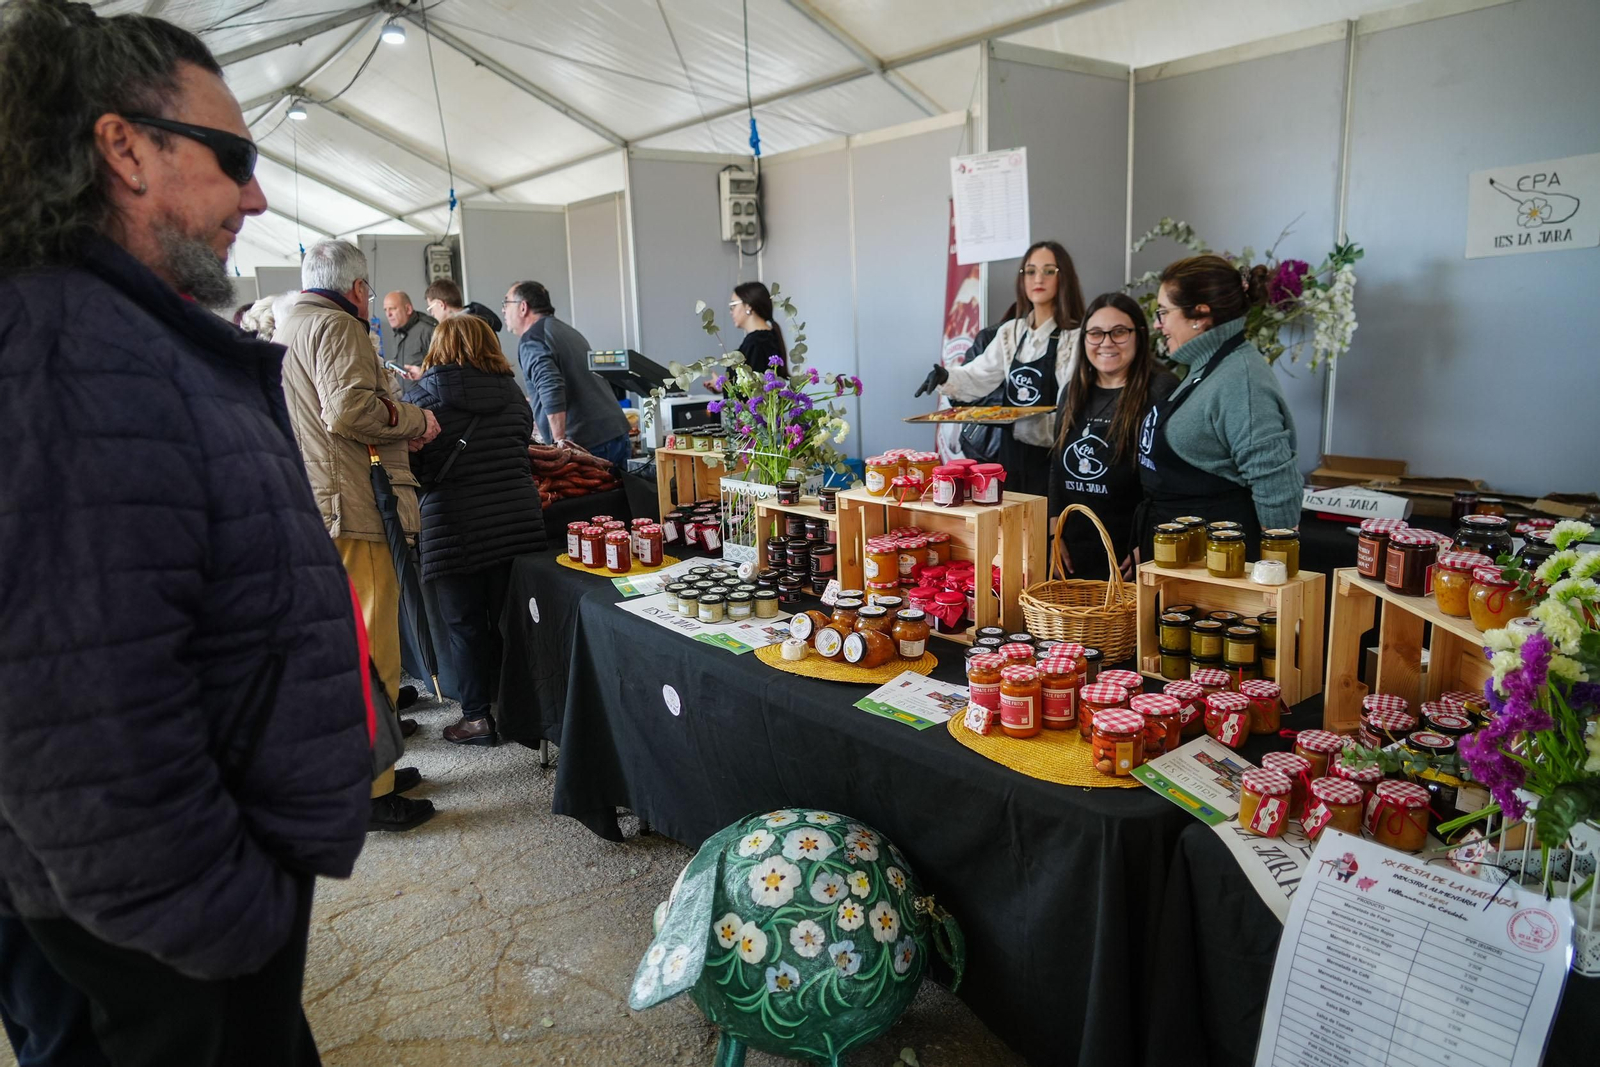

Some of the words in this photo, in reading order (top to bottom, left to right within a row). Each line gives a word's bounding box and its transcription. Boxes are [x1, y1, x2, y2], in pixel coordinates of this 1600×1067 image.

[1494, 235, 1513, 248] IES
[1518, 232, 1532, 246] LA
[1538, 228, 1572, 243] JARA
[1065, 481, 1075, 490] IES
[1076, 482, 1084, 492] LA
[1086, 483, 1108, 494] JARA
[1306, 496, 1324, 504] IES
[1328, 498, 1341, 506] LA
[1346, 499, 1378, 511] JARA
[642, 606, 662, 616] IES
[670, 619, 701, 631] JARA
[1161, 762, 1175, 774] IES
[1178, 774, 1188, 782] LA
[1191, 782, 1217, 799] JARA
[1252, 846, 1302, 900] JARA
[1393, 873, 1428, 889] INDUSTRIA
[1428, 887, 1478, 908] ALIMENTARIA
[1397, 863, 1431, 879] FIESTA
[1432, 875, 1446, 885] DE
[1449, 881, 1462, 892] LA
[1466, 887, 1519, 909] MATANZA
[1344, 902, 1369, 915] Mermelada
[1357, 897, 1385, 910] PRODUCTO
[1332, 910, 1356, 923] Mermelada
[1326, 920, 1351, 933] Mermelada
[1330, 933, 1355, 946] Mermelada
[1465, 937, 1477, 945] PVP
[1326, 946, 1351, 958] Mermelada
[1326, 958, 1351, 971] Mermelada
[1318, 968, 1342, 982] Mermelada
[1320, 984, 1344, 998] Mermelada
